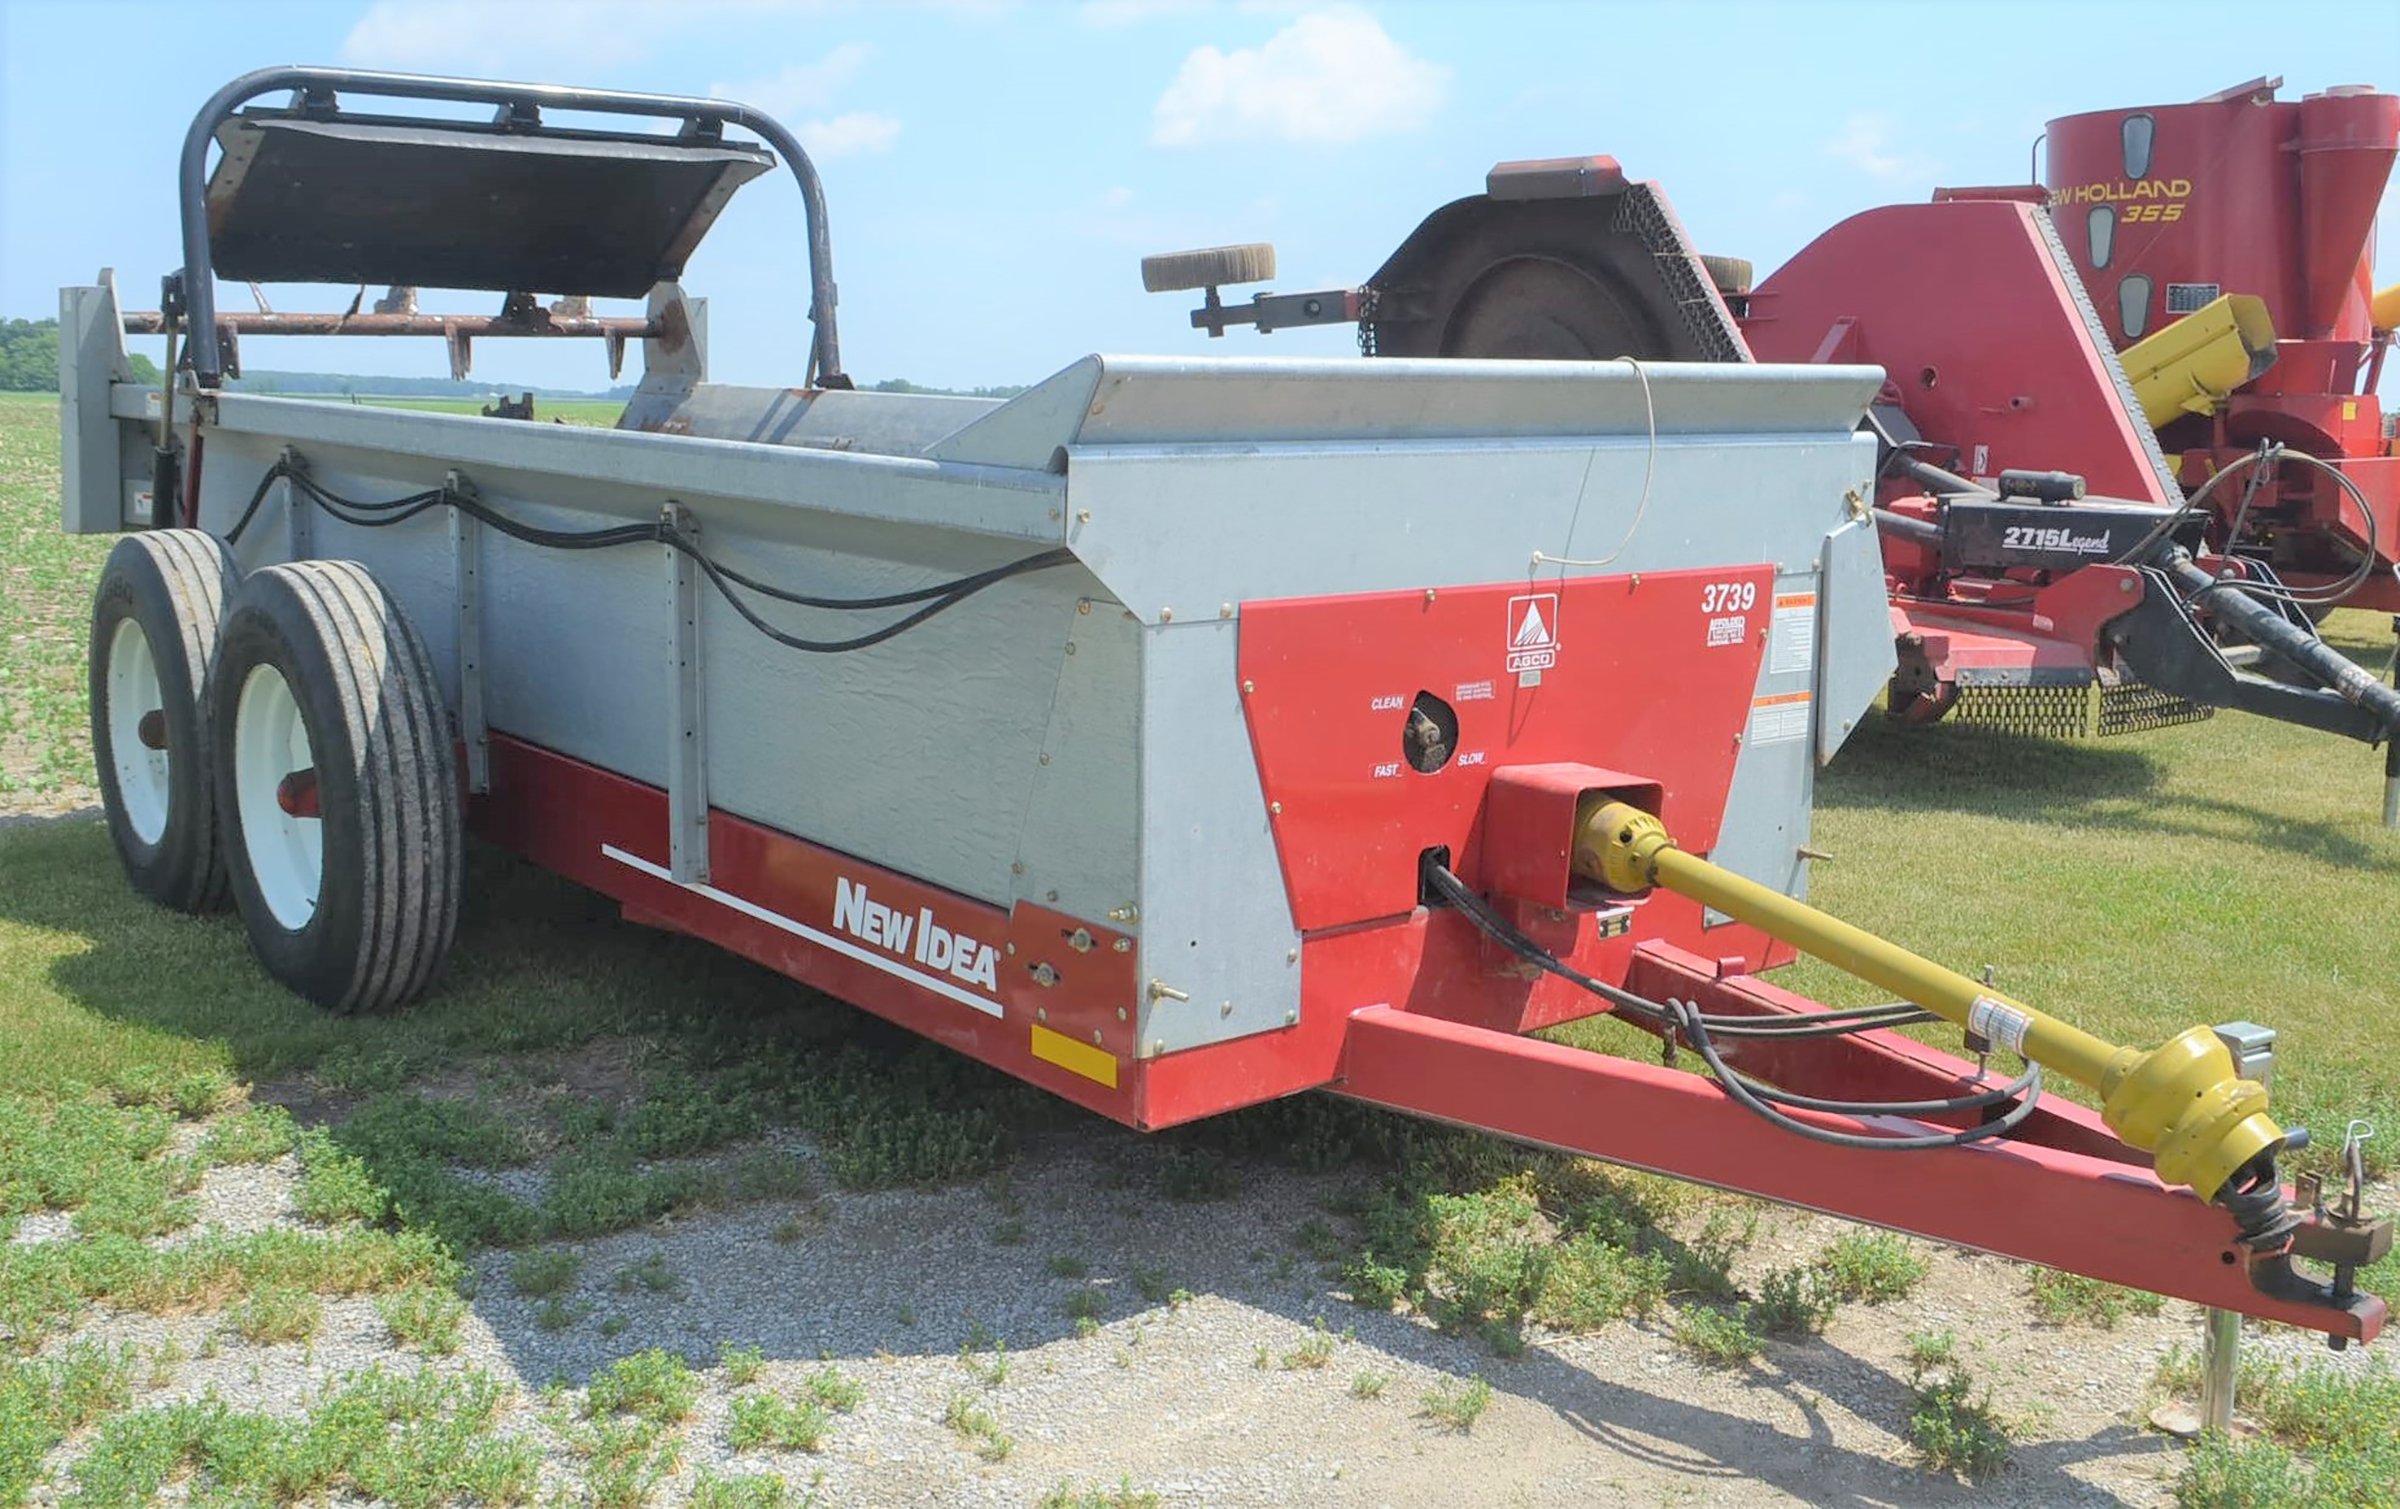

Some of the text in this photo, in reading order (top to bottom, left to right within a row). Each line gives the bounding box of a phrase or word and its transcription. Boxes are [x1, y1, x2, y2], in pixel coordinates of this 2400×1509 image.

[2048, 179, 2192, 207] EW HOLLAND
[2120, 203, 2186, 224] 355
[1701, 581, 1756, 613] 3739
[1512, 654, 1551, 668] AGCO
[1370, 696, 1404, 711] CLEAN
[1457, 752, 1485, 766] SLOW
[1374, 763, 1399, 778] FAST
[832, 876, 1000, 992] NEW IDEA
